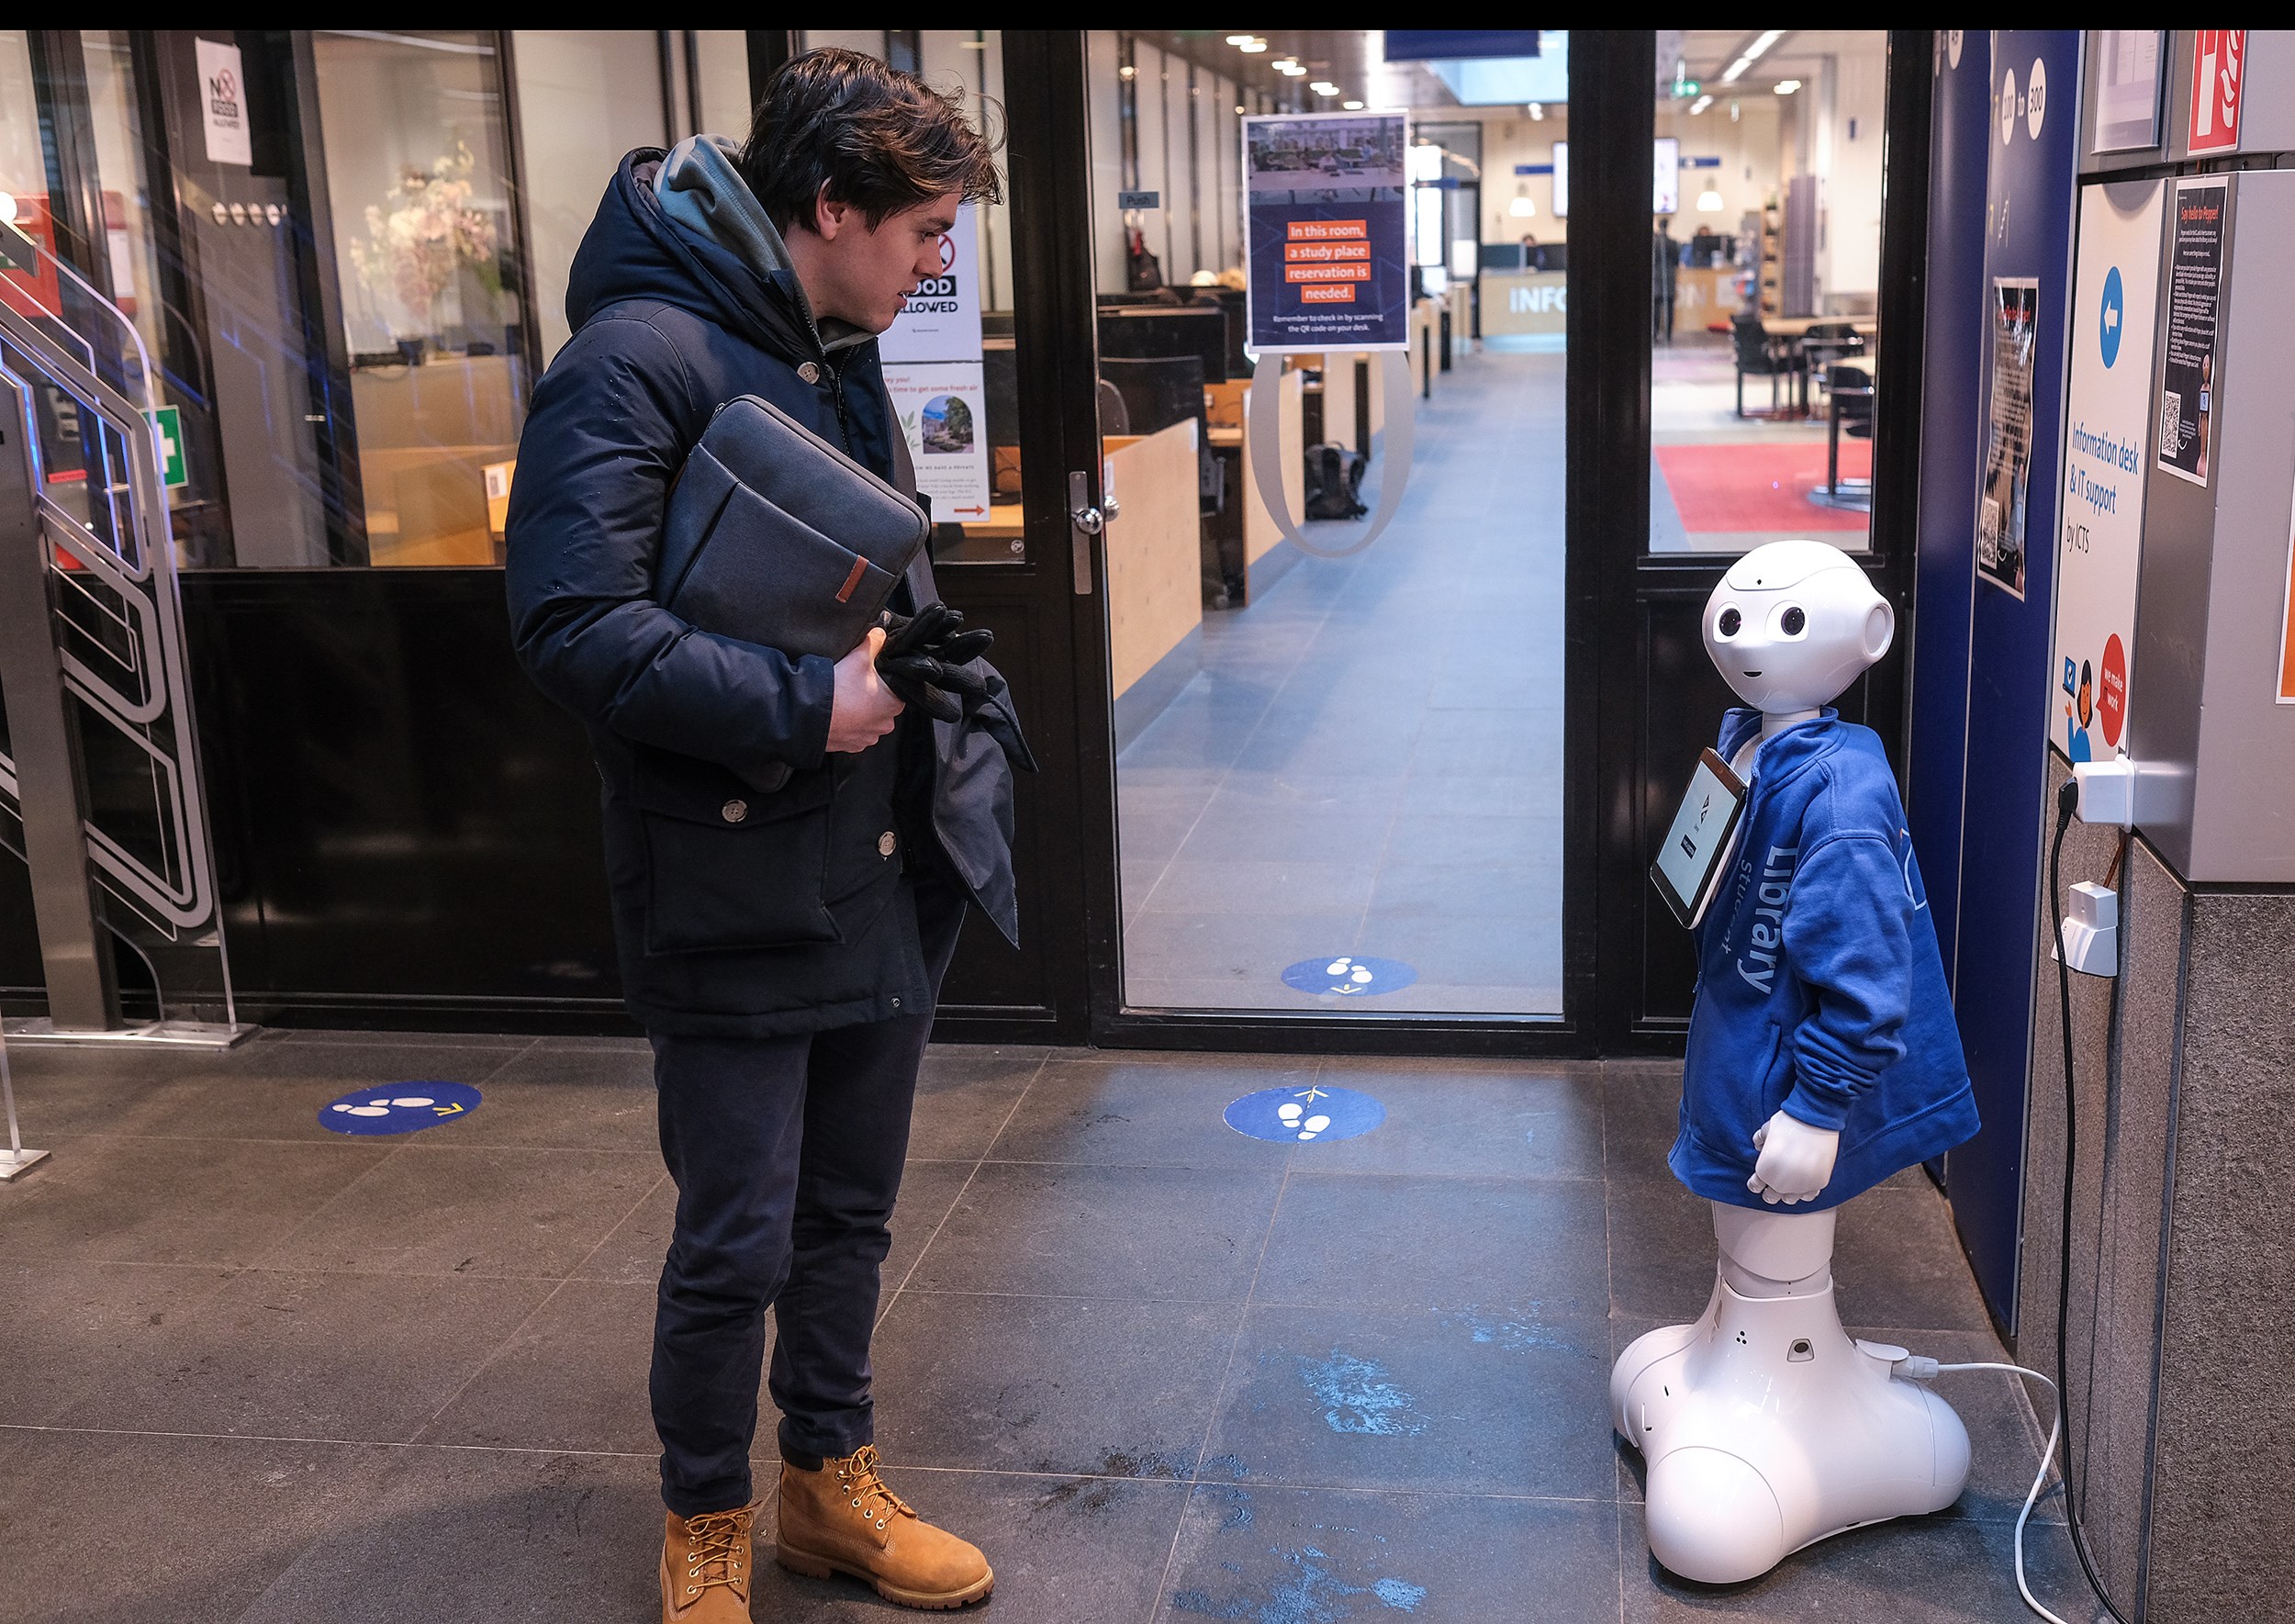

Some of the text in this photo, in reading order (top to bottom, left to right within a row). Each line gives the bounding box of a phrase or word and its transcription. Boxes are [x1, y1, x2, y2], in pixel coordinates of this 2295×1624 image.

[2030, 85, 2043, 113] 300
[1291, 226, 1364, 238] In this room,
[1290, 245, 1365, 261] a study place
[1290, 265, 1367, 279] reservation is
[1305, 286, 1351, 299] needed.
[1344, 314, 1353, 322] by
[1337, 325, 1352, 333] your
[2072, 421, 2139, 475] Information desk
[2070, 464, 2116, 517] & IT support
[2066, 516, 2089, 554] by ICTS
[2104, 667, 2123, 692] we make
[1737, 846, 1798, 995] Library
